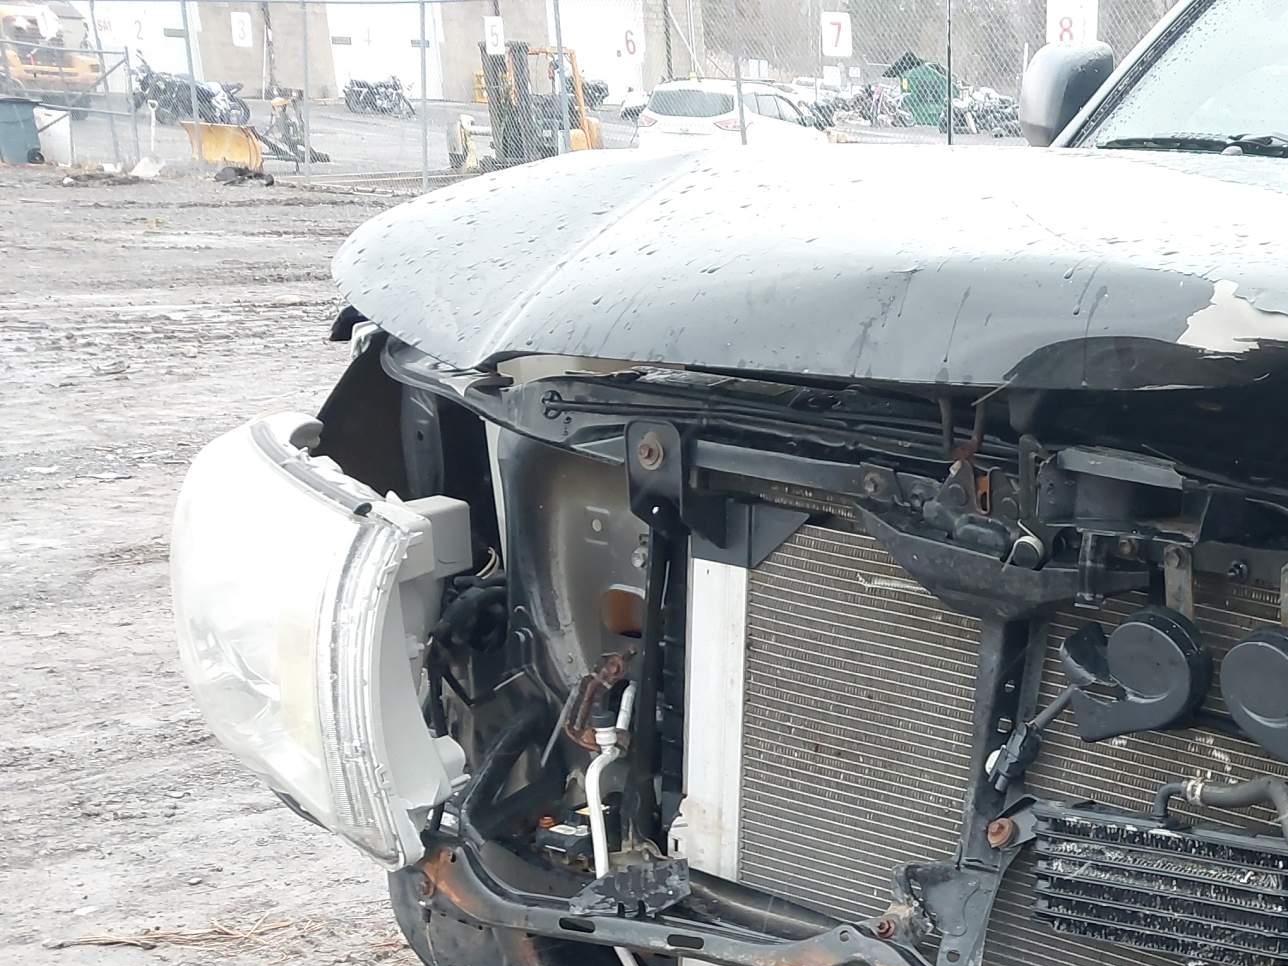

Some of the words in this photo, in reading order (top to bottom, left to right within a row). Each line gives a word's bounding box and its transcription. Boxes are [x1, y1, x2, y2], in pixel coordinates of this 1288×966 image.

[134, 19, 144, 41] 2
[236, 18, 246, 41] 3
[489, 23, 500, 48] 5
[829, 21, 843, 48] 7
